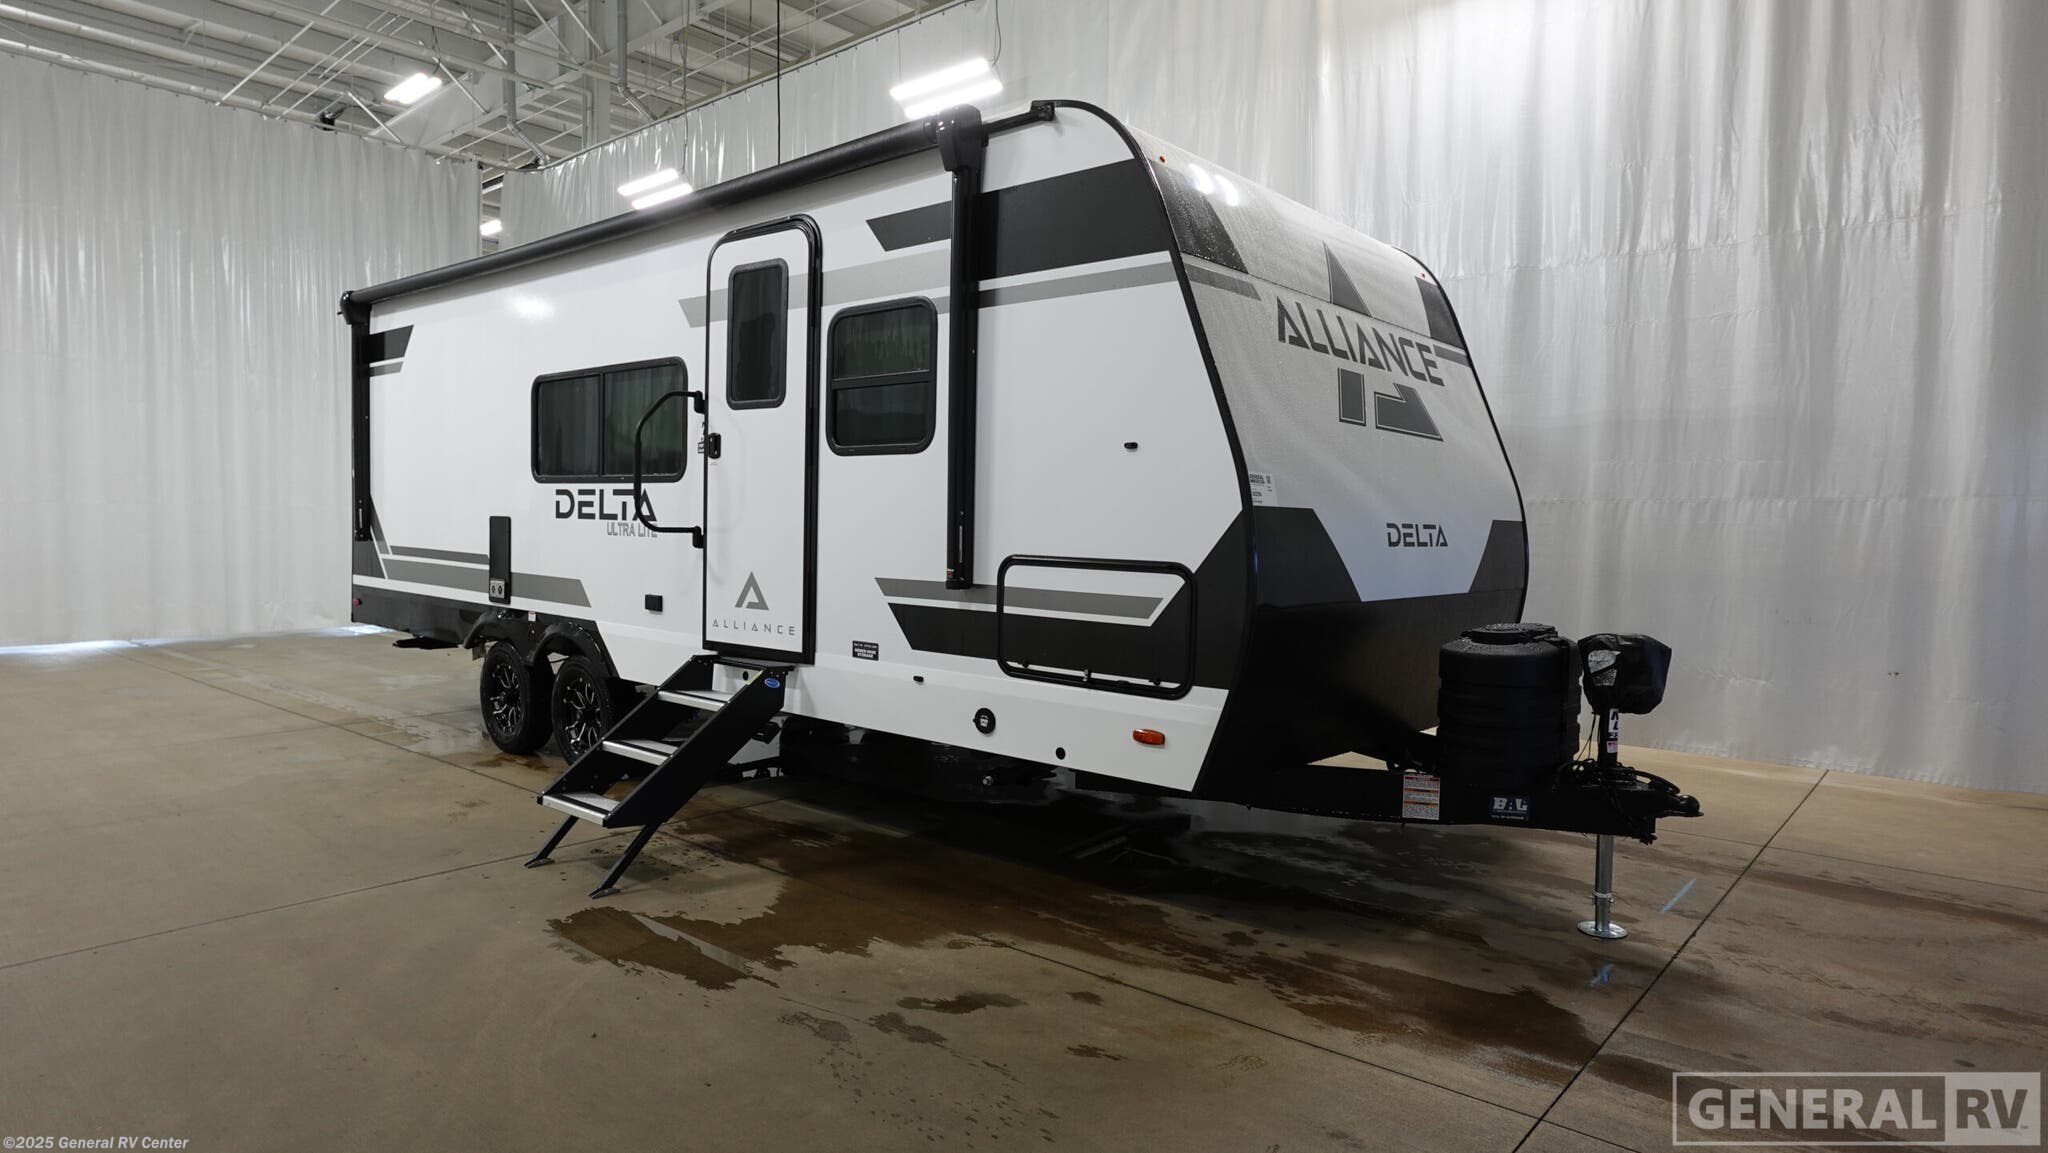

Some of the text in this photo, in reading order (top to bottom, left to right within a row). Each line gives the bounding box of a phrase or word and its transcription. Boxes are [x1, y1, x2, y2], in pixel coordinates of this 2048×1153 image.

[1276, 296, 1445, 387] ALLIANCE
[555, 488, 657, 522] DELTA
[607, 522, 636, 537] ULTRA
[1386, 522, 1449, 548] DELTA
[712, 618, 796, 636] ALLIANCE
